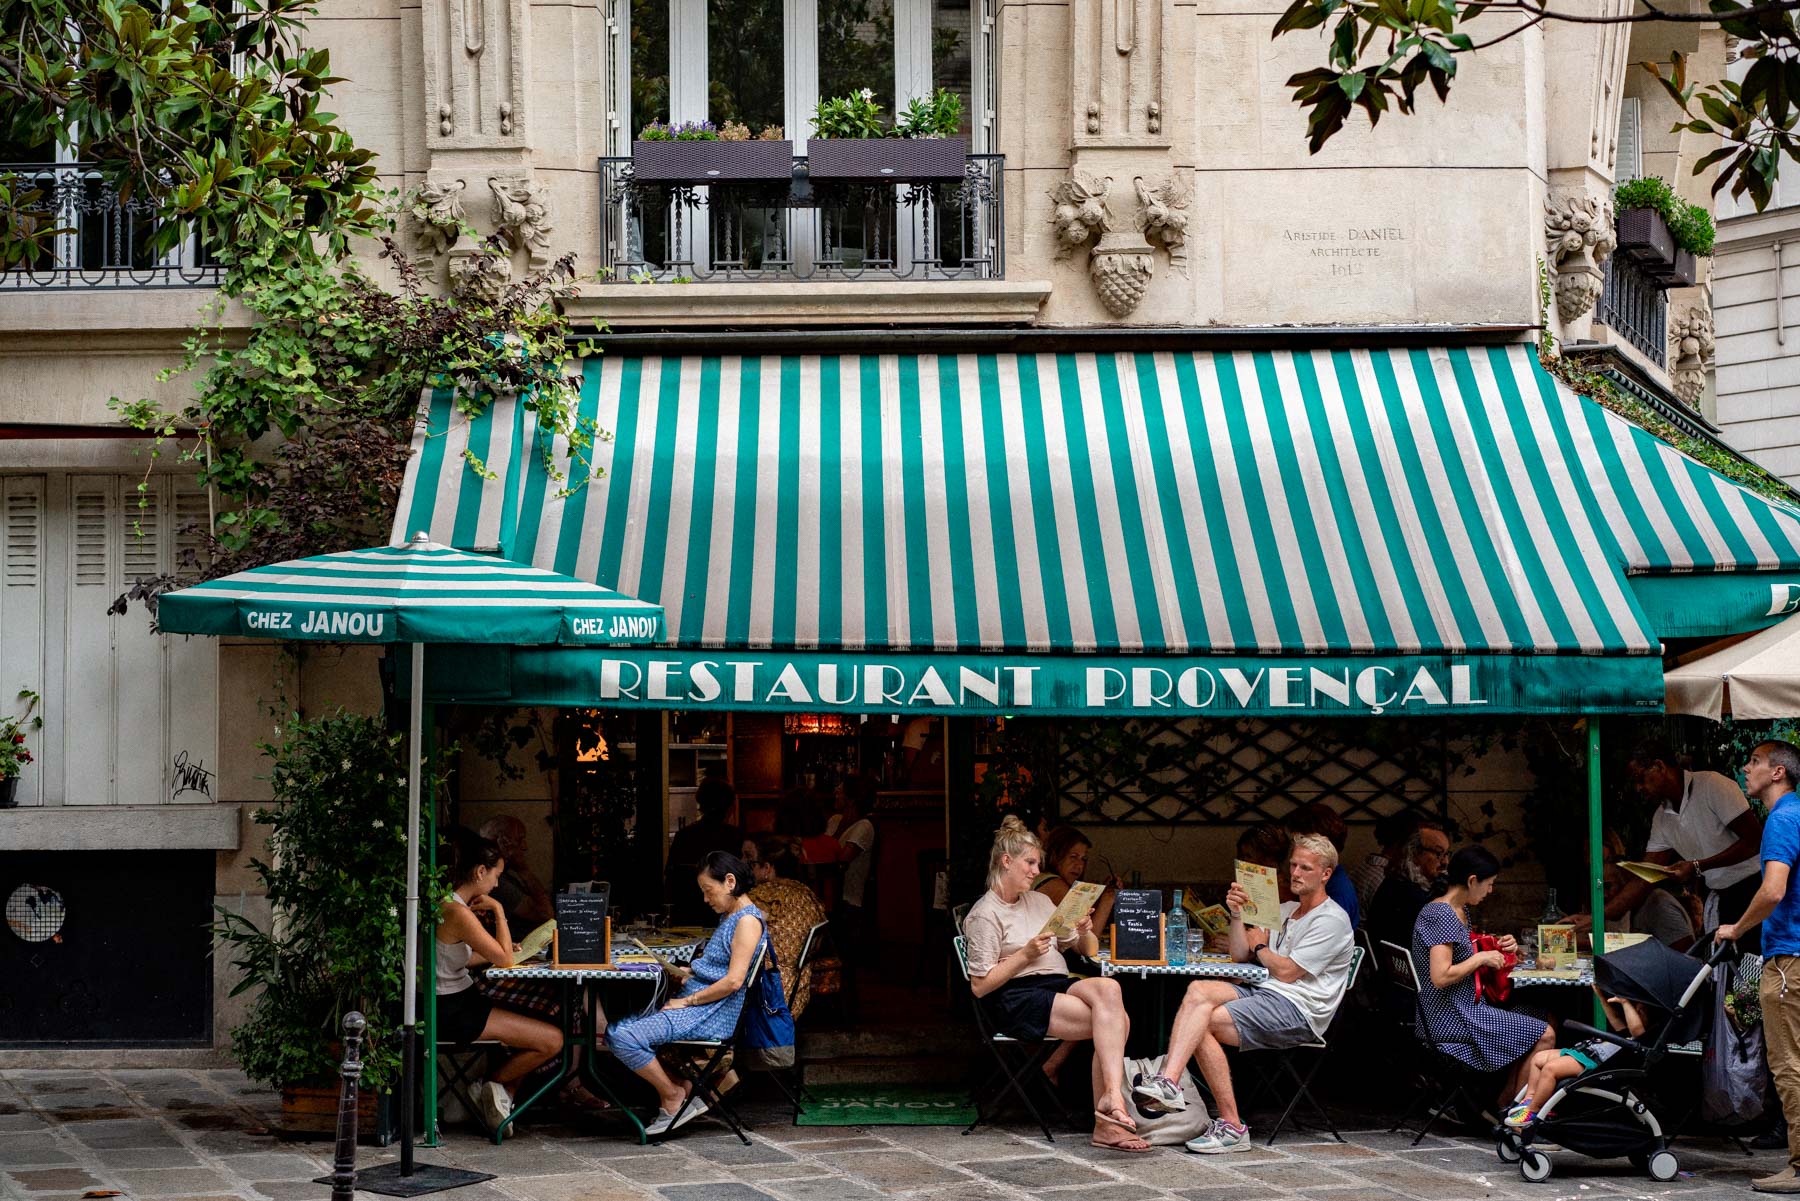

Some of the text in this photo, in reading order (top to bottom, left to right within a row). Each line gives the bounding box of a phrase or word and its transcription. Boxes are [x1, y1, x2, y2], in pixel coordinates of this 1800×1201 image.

[1348, 228, 1407, 241] DANIEL
[1310, 248, 1381, 257] ARCHITECTE
[247, 610, 384, 637] CHEZ JANOU
[573, 616, 656, 638] CHEZ JANOU
[600, 659, 1488, 715] RESTAURANT PROVENÇAL
